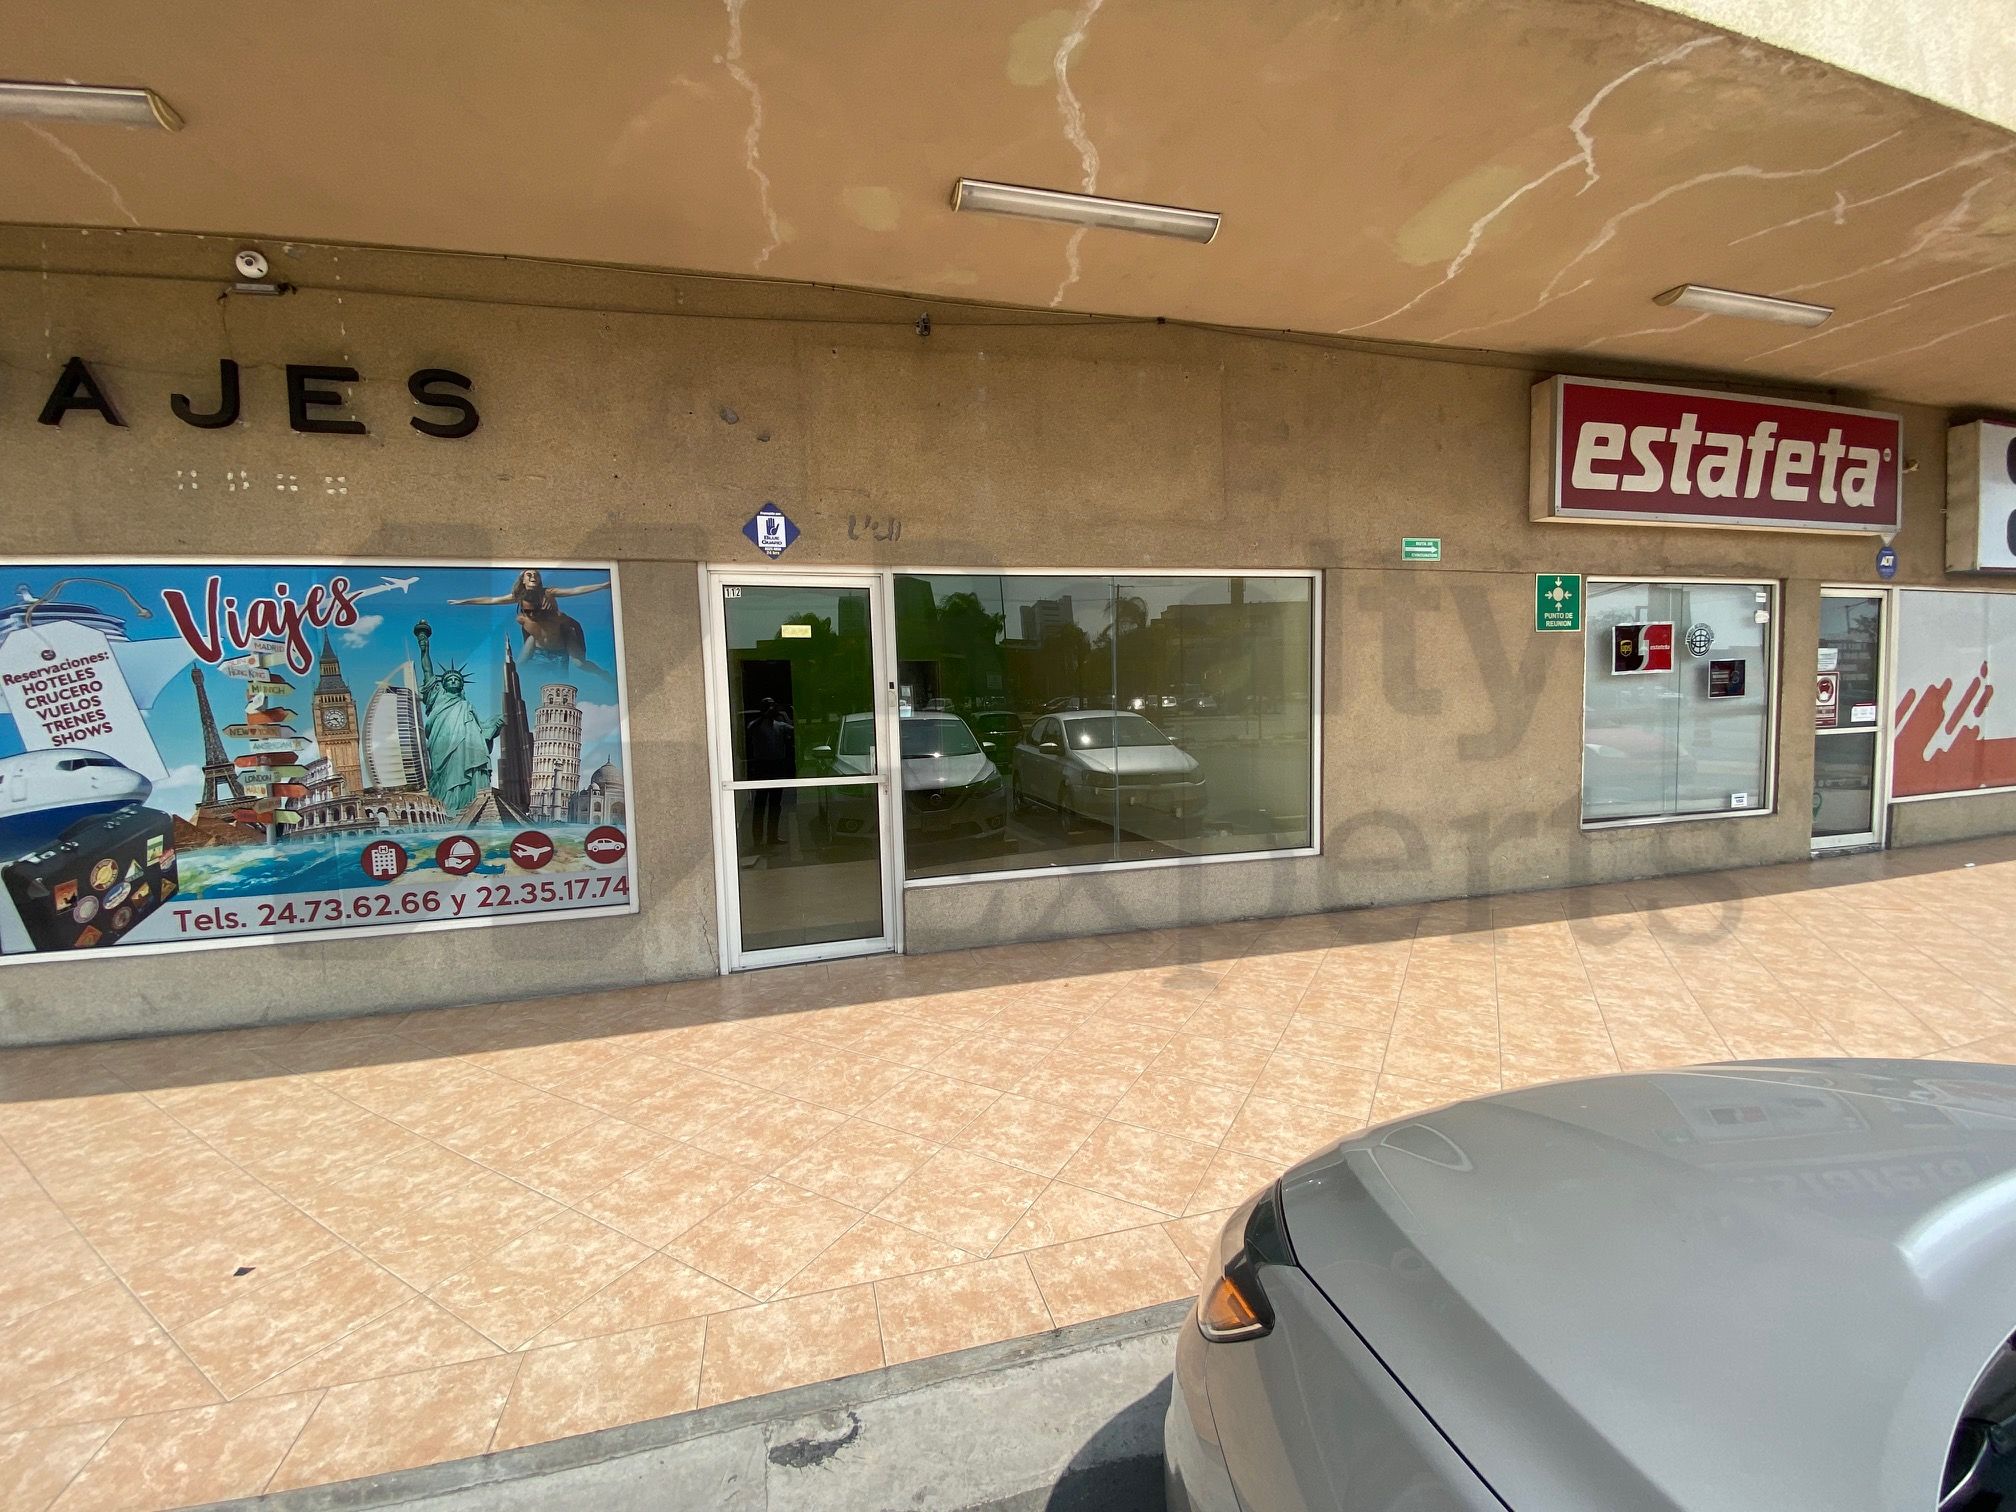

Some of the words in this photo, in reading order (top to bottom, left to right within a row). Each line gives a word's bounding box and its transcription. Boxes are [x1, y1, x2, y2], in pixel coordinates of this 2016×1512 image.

[38, 356, 480, 439] AJES
[1571, 412, 1881, 507] estafeta
[725, 587, 741, 598] 112
[162, 575, 364, 676] Viajes
[254, 642, 286, 653] MADRID
[2, 651, 110, 686] Reservaciones:
[22, 667, 96, 696] HOTELES
[25, 680, 103, 710] CRUCERO
[36, 695, 102, 721] VUELOS
[42, 708, 107, 734] TRENES
[51, 721, 114, 747] SHOWS
[229, 728, 249, 736] NEW
[244, 774, 272, 783] LONDON
[173, 906, 248, 932] Tels.
[257, 891, 441, 927] 24.73.62.66
[451, 892, 467, 916] y
[476, 875, 630, 908] 22.35.17.74
